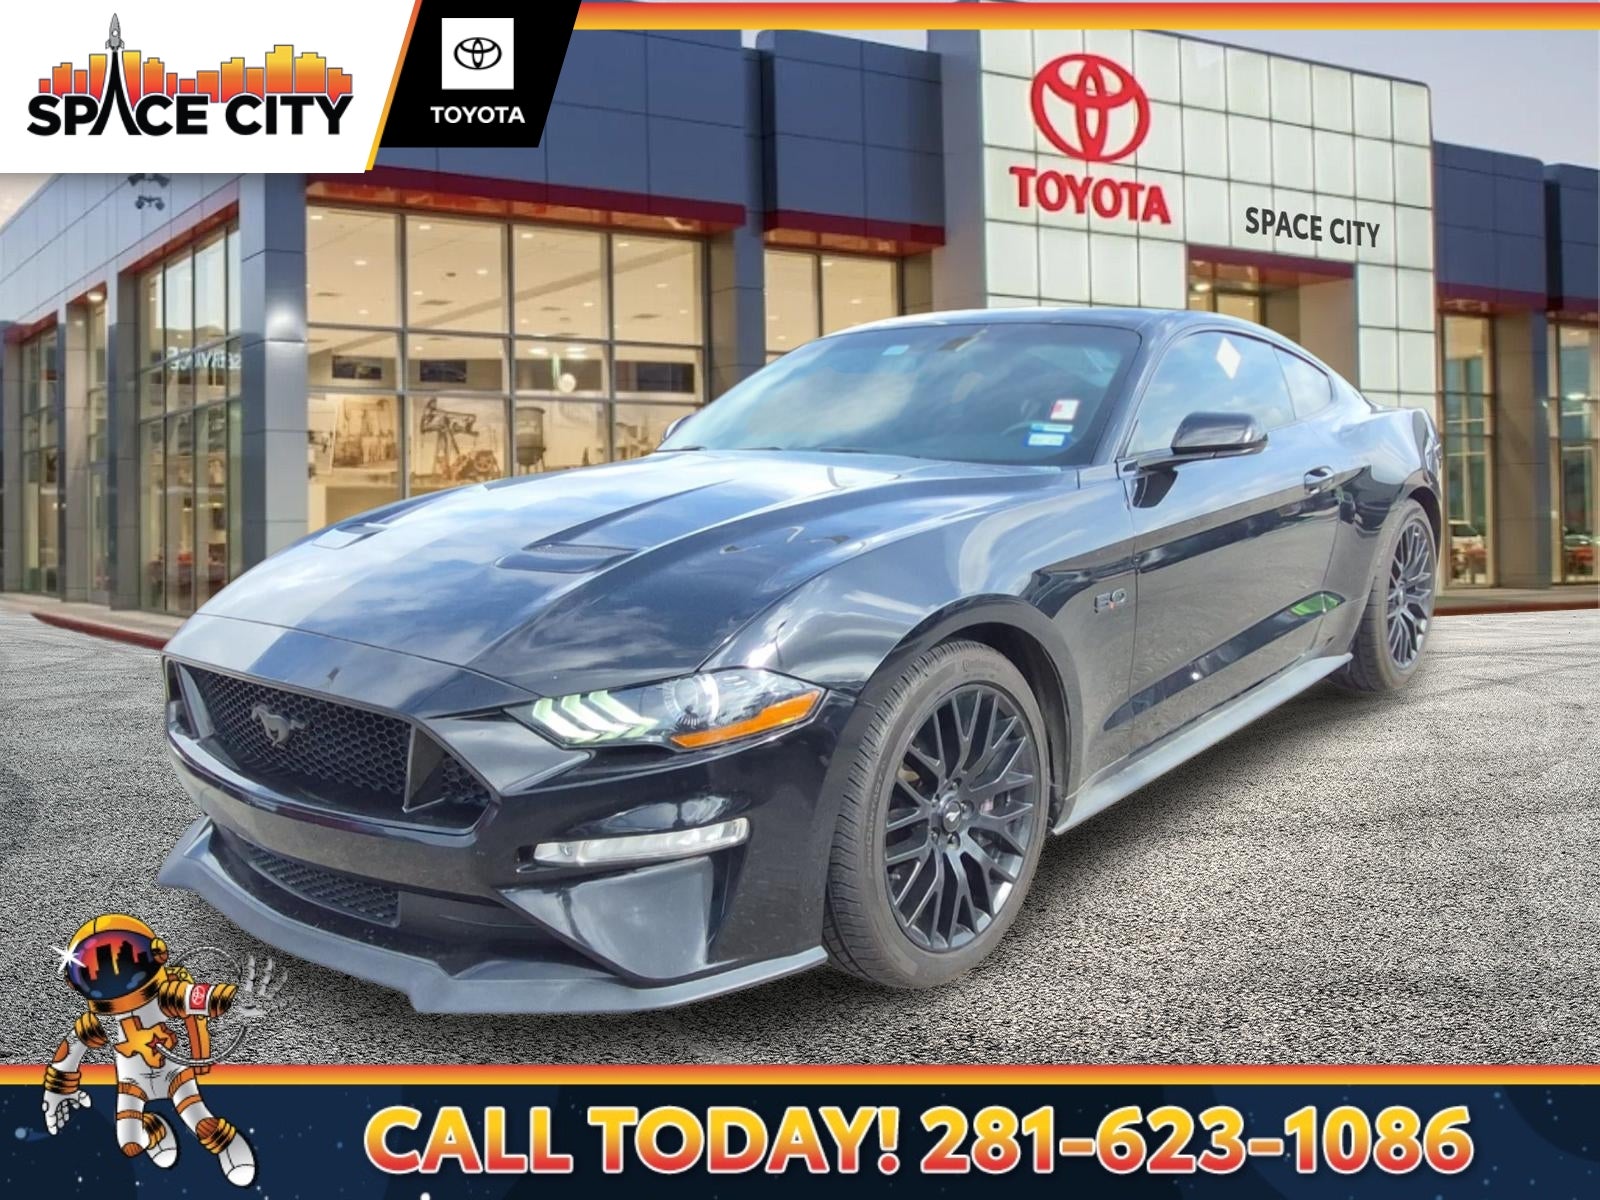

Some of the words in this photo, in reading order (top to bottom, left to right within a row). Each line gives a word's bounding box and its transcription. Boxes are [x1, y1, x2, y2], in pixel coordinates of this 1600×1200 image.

[1009, 166, 1171, 224] TOYOTA
[1245, 207, 1322, 241] SPACE
[1329, 218, 1380, 248] CITY
